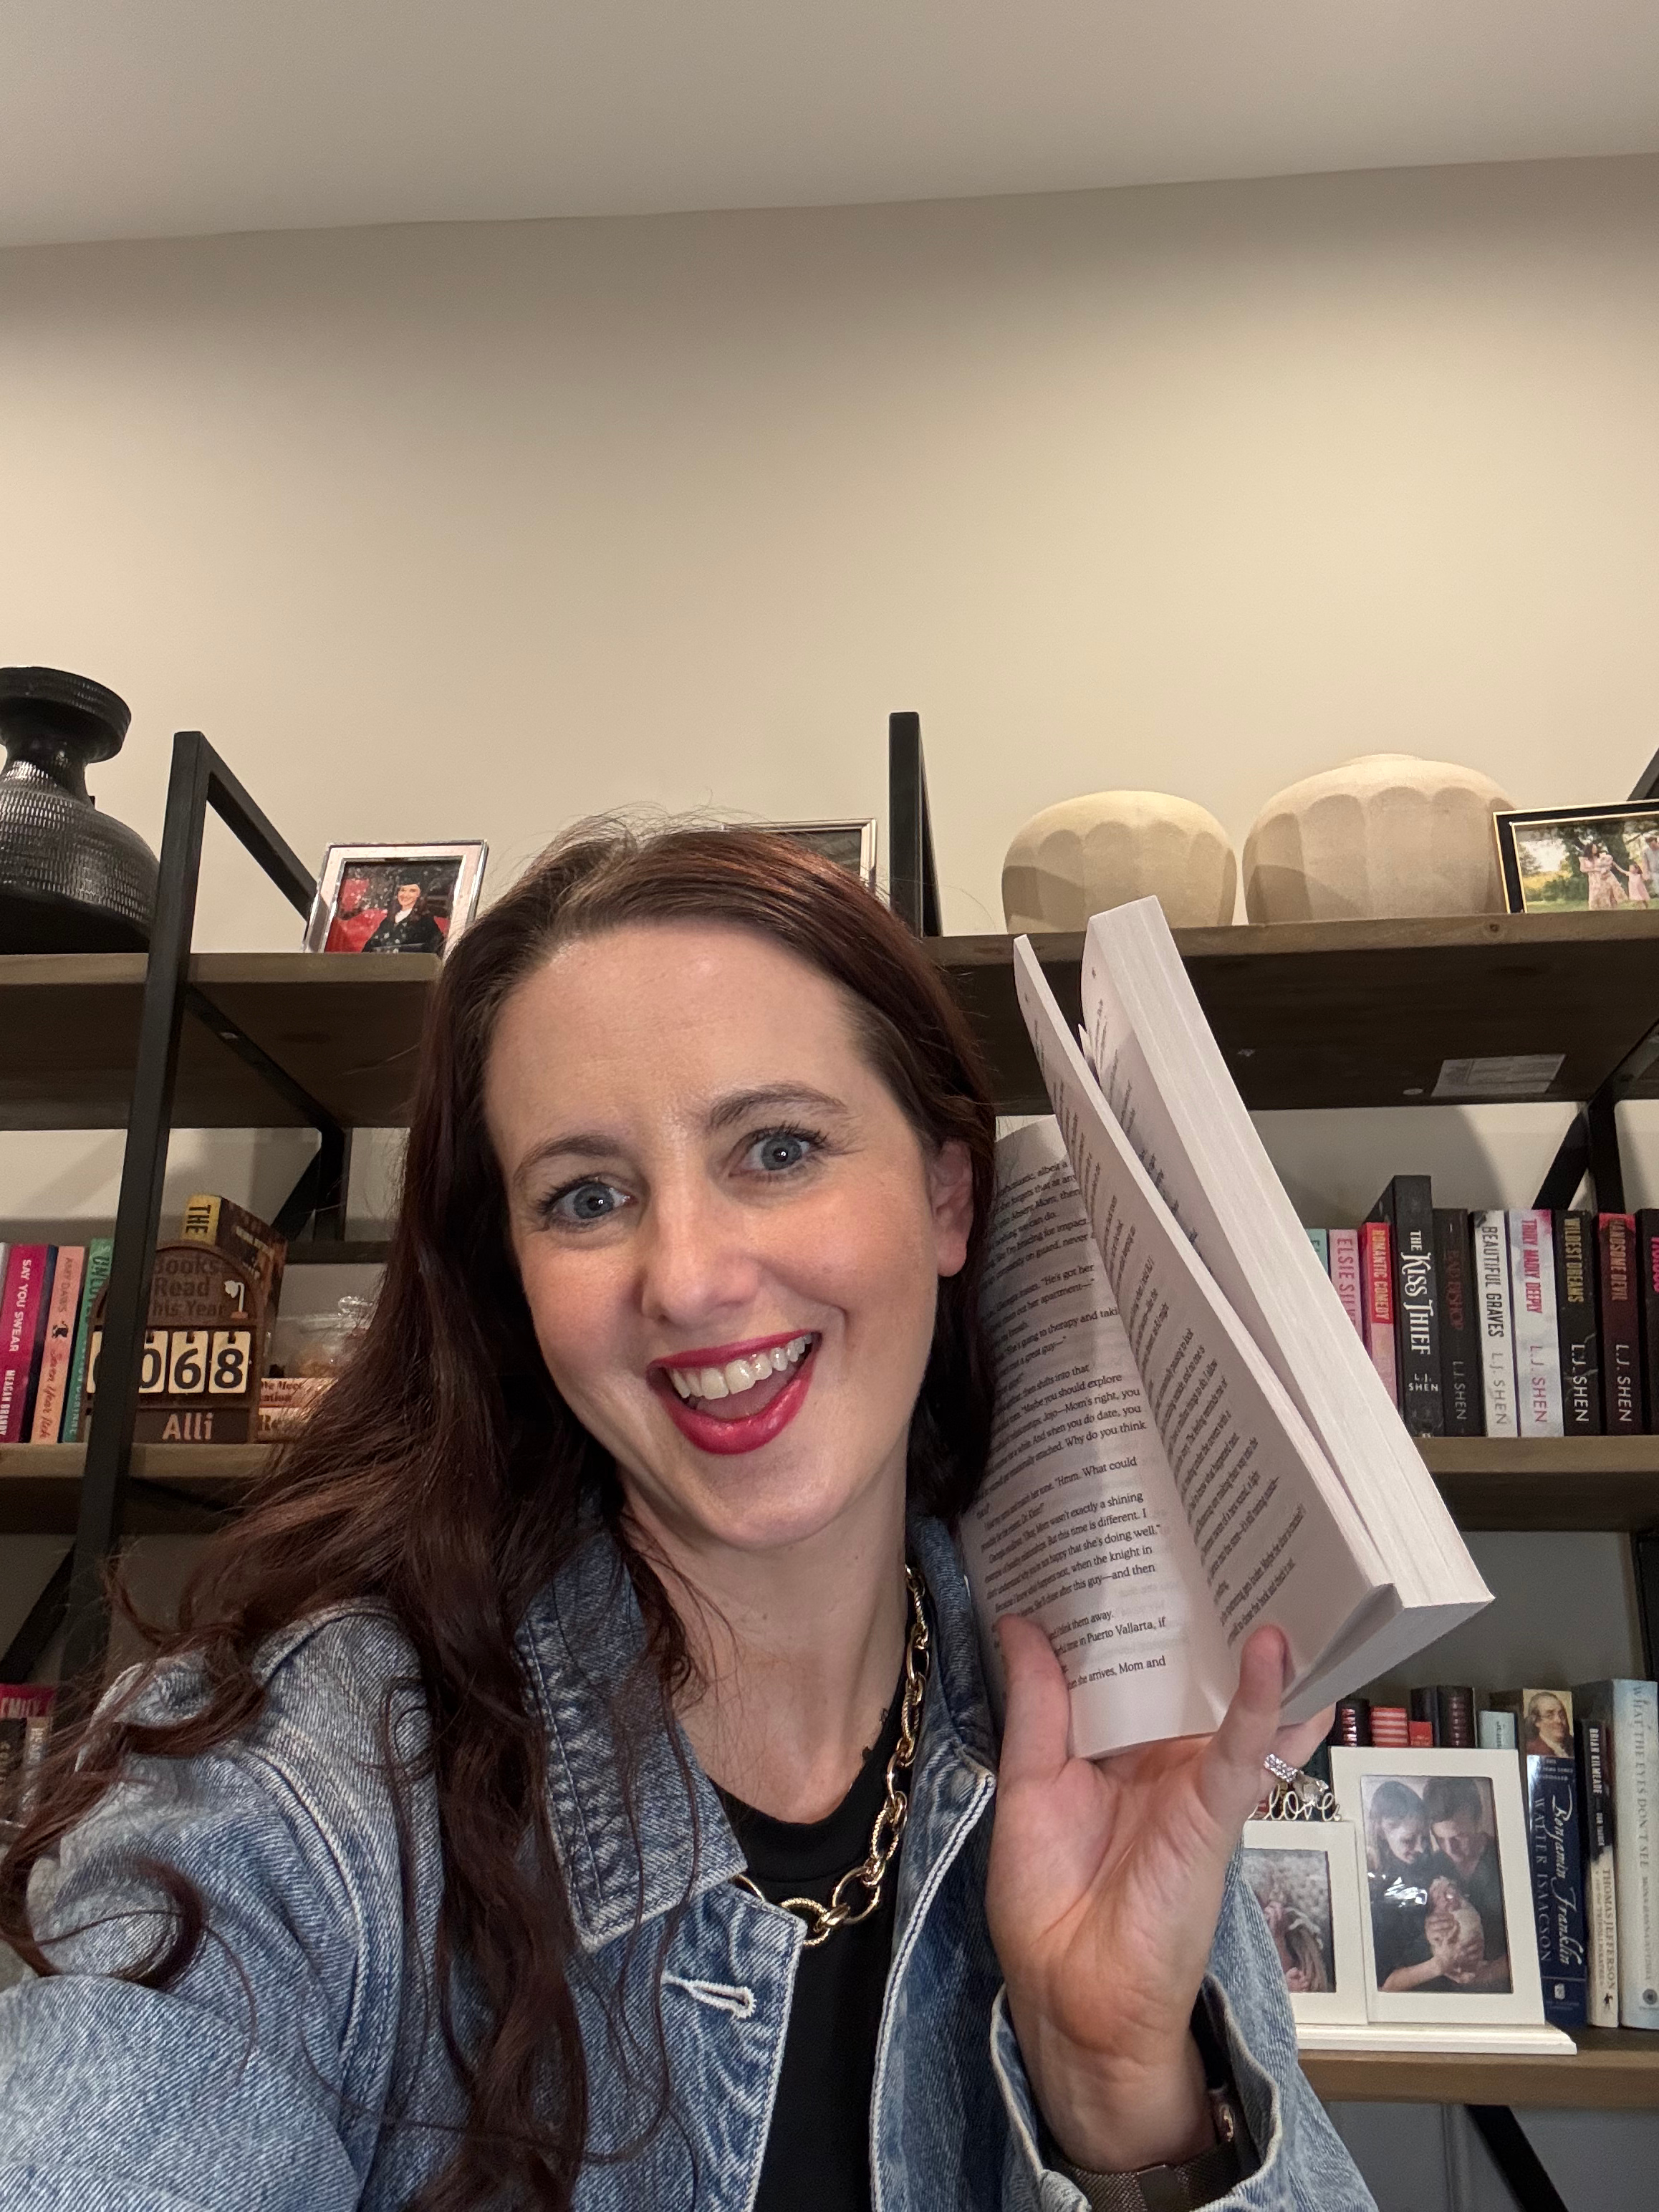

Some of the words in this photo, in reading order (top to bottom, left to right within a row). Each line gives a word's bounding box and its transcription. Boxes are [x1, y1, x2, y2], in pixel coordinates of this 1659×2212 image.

[186, 1205, 211, 1234] THE
[1521, 1218, 1538, 1246] TRULY
[1372, 1230, 1388, 1279] ROMANTIC
[1410, 1230, 1423, 1251] THE
[1564, 1218, 1582, 1259] WILDEST
[20, 1259, 32, 1281] SAY
[1063, 1269, 1076, 1281] got
[1079, 1265, 1095, 1274] her
[1337, 1238, 1355, 1279] ELSIE
[1481, 1226, 1501, 1287] BEAUTIFUL
[1523, 1249, 1540, 1279] MADLY
[155, 1276, 210, 1297] Read
[1400, 1252, 1431, 1297] KISS
[1566, 1262, 1585, 1302] DREAMS
[1611, 1274, 1628, 1301] DEVIL
[16, 1284, 29, 1307] YOU
[153, 1299, 178, 1317] his
[186, 1300, 226, 1317] Year
[1374, 1281, 1390, 1319] COMEDY
[1525, 1282, 1543, 1314] DEEPLY
[9, 1311, 24, 1352] SWEAR
[1039, 1329, 1047, 1338] to
[1048, 1317, 1079, 1334] therapy
[1080, 1311, 1098, 1322] and
[1403, 1299, 1434, 1355] THIEF
[1486, 1293, 1504, 1338] GRAVES
[1037, 1377, 1054, 1390] shifts
[1055, 1370, 1072, 1382] into
[1072, 1364, 1090, 1376] that
[1188, 1362, 1196, 1374] no
[1193, 1350, 1202, 1365] one
[1044, 1393, 1057, 1405] you
[1059, 1381, 1086, 1398] should
[1087, 1374, 1122, 1389] explore
[1095, 1393, 1120, 1405] right,
[1121, 1388, 1140, 1400] you
[1408, 1382, 1438, 1391] SHEN
[1454, 1382, 1467, 1420] SHEN
[1494, 1380, 1508, 1425] SHEN
[1531, 1377, 1548, 1423] SHEN
[1573, 1376, 1590, 1423] SHEN
[1617, 1376, 1632, 1423] SHEN
[162, 1412, 215, 1441] Alli
[1033, 1430, 1046, 1444] And
[1047, 1424, 1066, 1437] when
[1067, 1419, 1082, 1430] you
[1084, 1414, 1095, 1424] do
[1097, 1410, 1120, 1421] date,
[1122, 1405, 1142, 1418] you
[1035, 1441, 1064, 1461] attached.
[1065, 1434, 1085, 1448] Why
[1086, 1430, 1098, 1441] do
[1100, 1427, 1117, 1440] you
[1119, 1420, 1147, 1433] think
[1054, 1471, 1082, 1487] "Hmm.
[1082, 1463, 1107, 1477] What
[1109, 1456, 1138, 1471] could
[1050, 1511, 1069, 1527] wasn't
[1070, 1501, 1099, 1518] exactly
[1107, 1493, 1143, 1507] shining
[1057, 1530, 1070, 1540] this
[1070, 1524, 1087, 1536] time
[1097, 1512, 1140, 1527] different.
[1142, 1507, 1147, 1519] I
[1049, 1549, 1067, 1564] happy
[1068, 1544, 1082, 1554] that
[1082, 1537, 1103, 1550] she's
[1105, 1531, 1133, 1544] doing
[1133, 1524, 1161, 1538] well."
[1071, 1560, 1093, 1573] when
[1093, 1555, 1107, 1566] the
[1110, 1547, 1140, 1562] knight
[1143, 1545, 1153, 1554] in
[1059, 1585, 1072, 1597] after
[1073, 1579, 1086, 1591] this
[1087, 1567, 1130, 1587] guy—and
[1133, 1563, 1155, 1574] then
[1072, 1617, 1089, 1630] them
[1090, 1610, 1115, 1624] away.
[1087, 1630, 1114, 1643] Puerto
[1115, 1620, 1157, 1635] Vallarta,
[1158, 1616, 1167, 1628] if
[1088, 1668, 1117, 1682] arrives,
[1118, 1660, 1144, 1673] Mom
[1146, 1655, 1166, 1668] and
[1589, 1728, 1600, 1753] BRIAN
[1633, 1733, 1645, 1756] THE
[1590, 1755, 1602, 1794] KILMEADE
[1635, 1763, 1646, 1794] EYES
[1534, 1798, 1548, 1864] WALTER
[1544, 1784, 1574, 1879] Benjamin
[1637, 1799, 1648, 1841] DON'T
[1639, 1847, 1649, 1867] SEE
[1602, 1869, 1614, 1920] THOMAS
[1537, 1874, 1552, 1961] ISAACSON
[1550, 1877, 1585, 1965] Franklin
[1603, 1921, 1616, 1991] JEFFERSON
